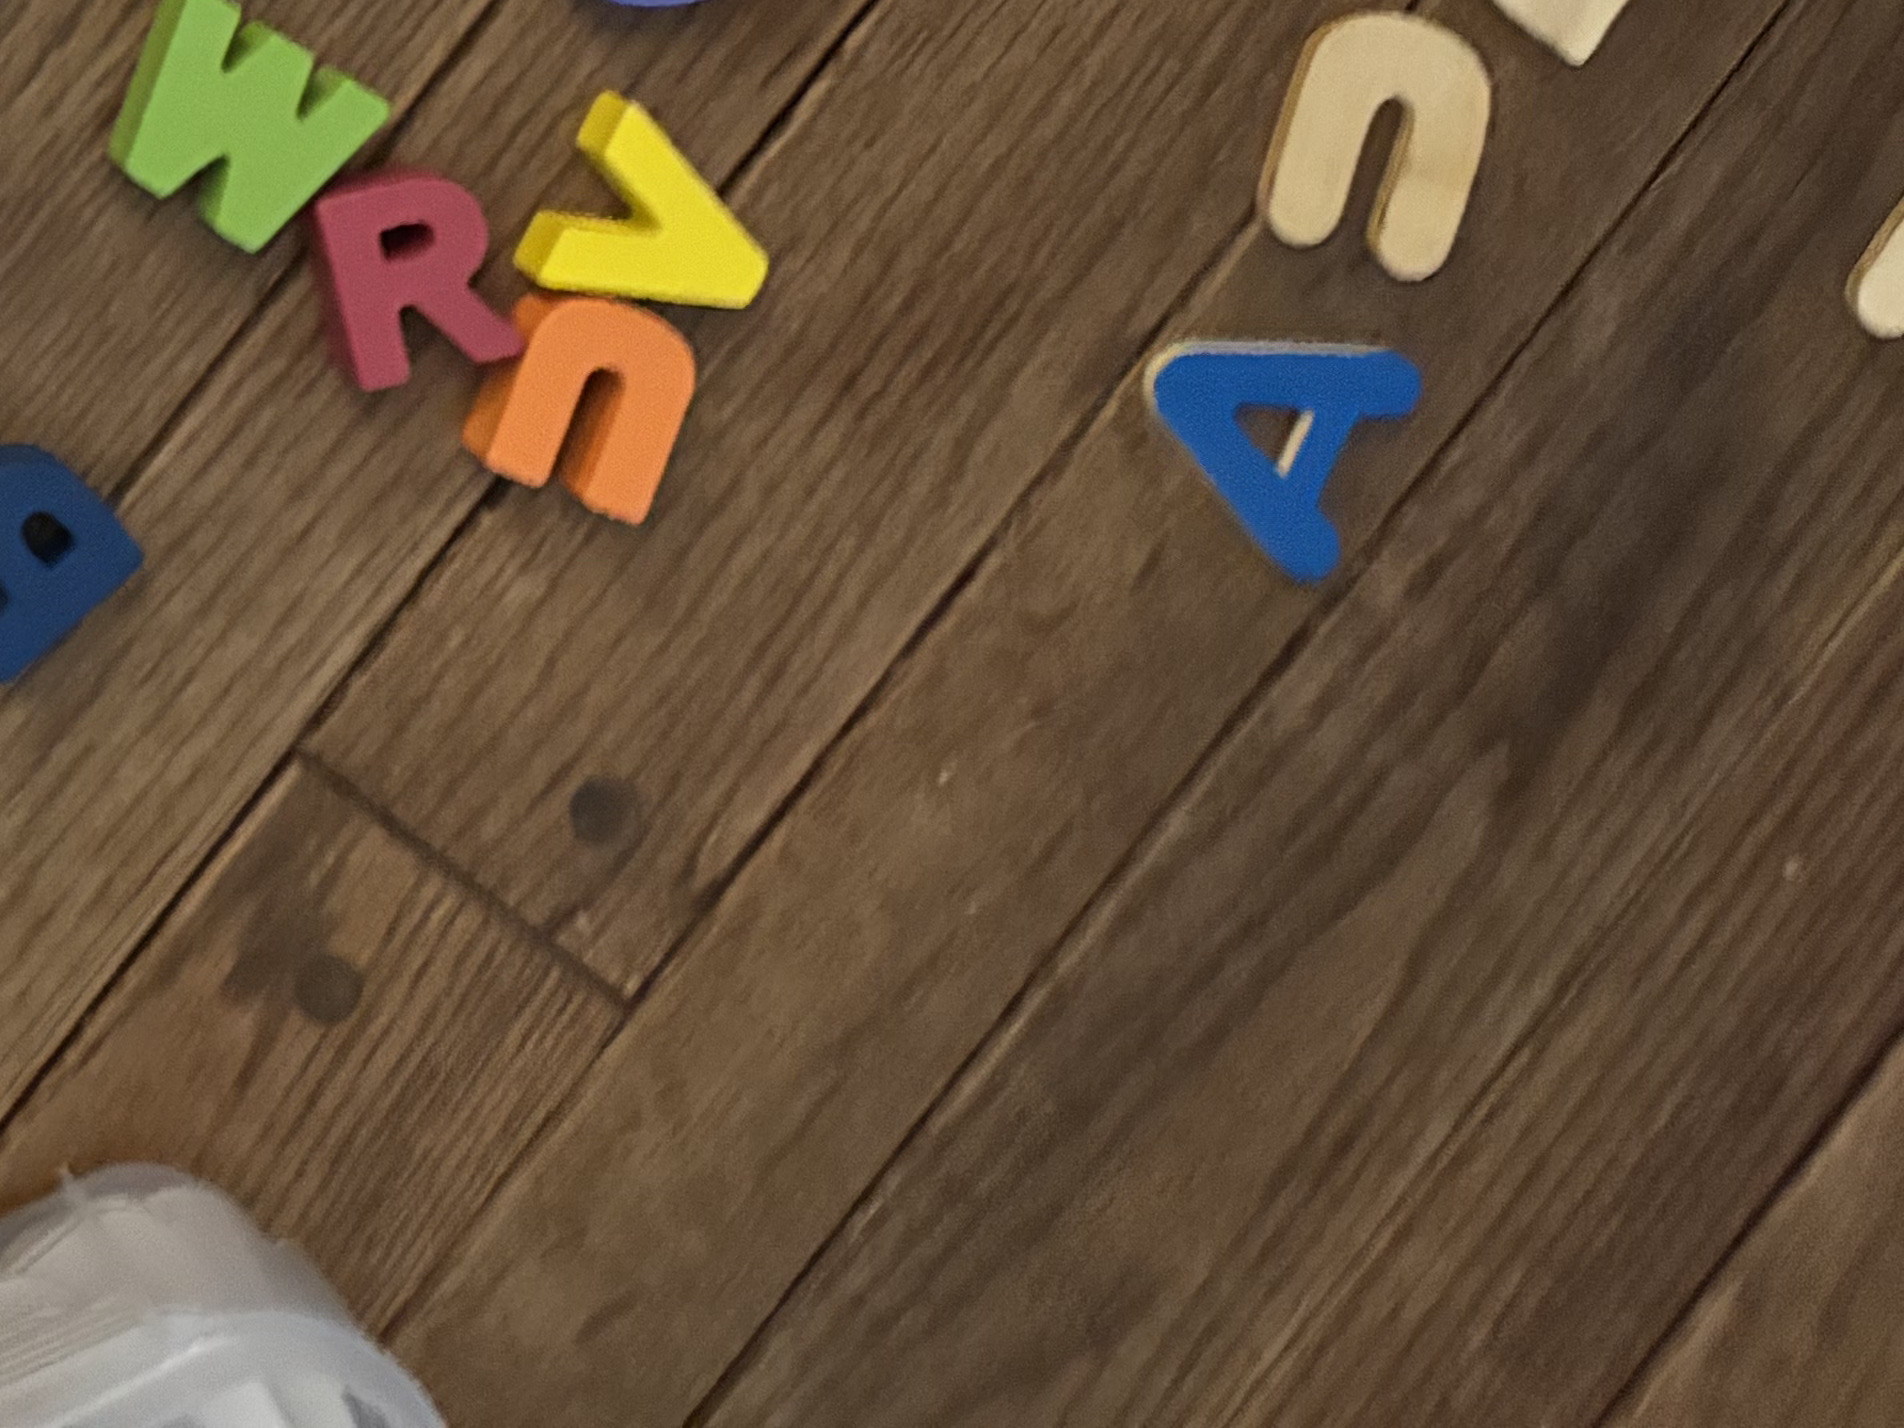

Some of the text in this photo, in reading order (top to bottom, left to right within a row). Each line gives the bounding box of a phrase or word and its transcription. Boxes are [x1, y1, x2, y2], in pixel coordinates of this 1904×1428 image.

[514, 89, 770, 310] V
[1259, 11, 1491, 282] U
[308, 165, 524, 394] R
[461, 294, 696, 526] U
[1145, 337, 1422, 583] A
